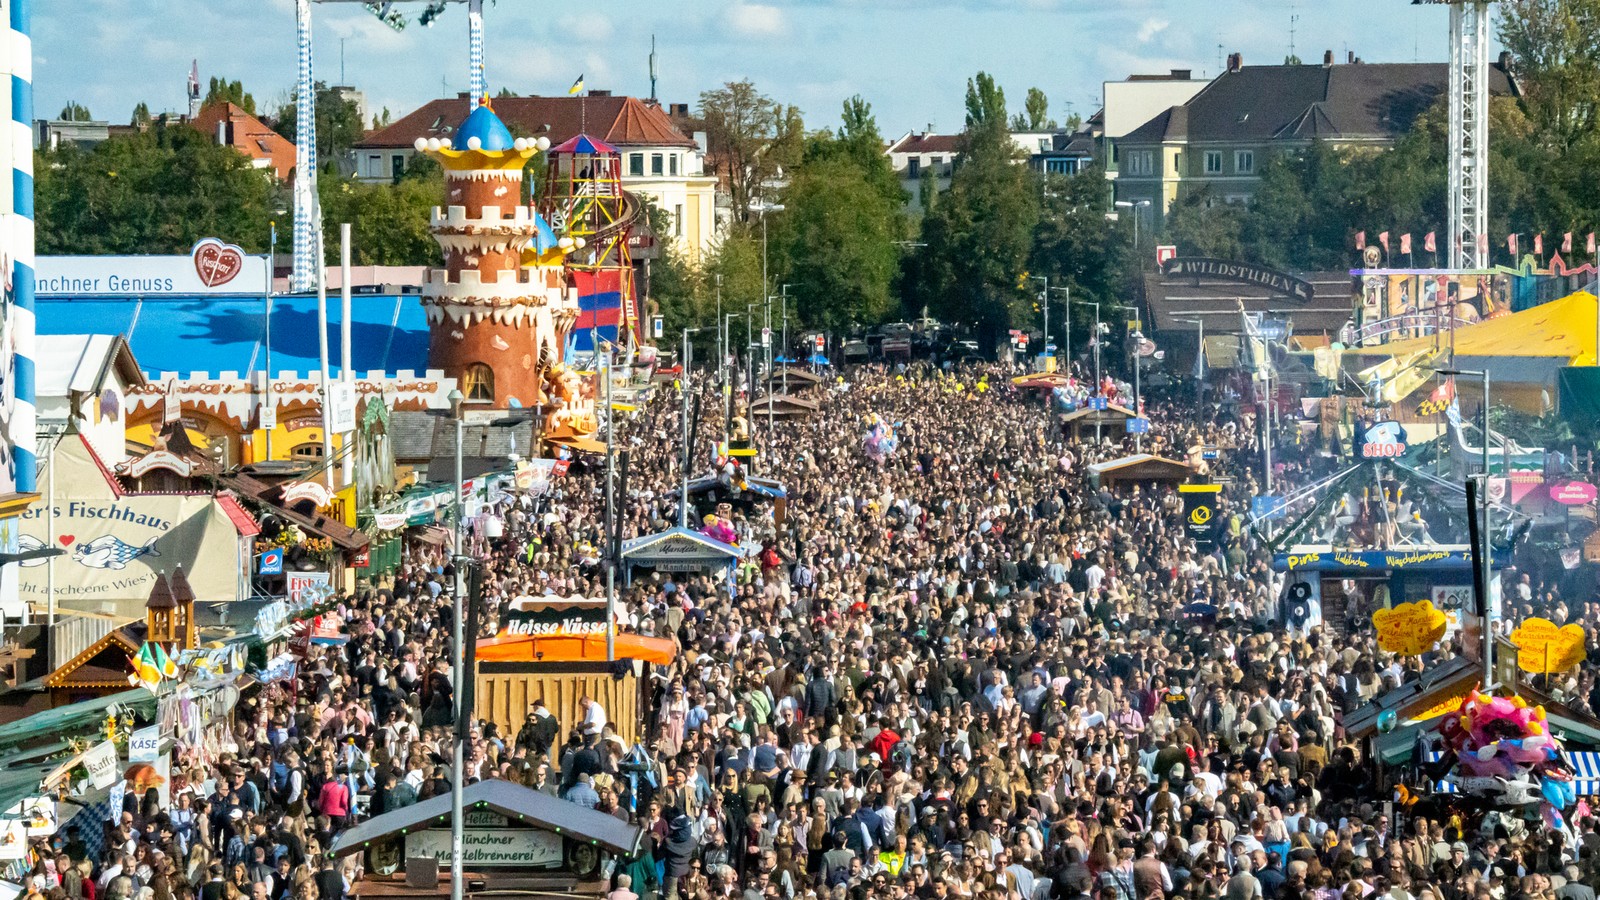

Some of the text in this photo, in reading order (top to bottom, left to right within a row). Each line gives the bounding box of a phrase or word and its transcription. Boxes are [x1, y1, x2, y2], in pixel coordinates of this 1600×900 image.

[108, 275, 173, 291] Genuss
[1186, 261, 1293, 292] WILDSTUBEN
[1363, 443, 1405, 457] SHOP
[69, 502, 171, 531] Fischhaus
[1287, 552, 1320, 570] Pins
[54, 584, 110, 595] scheene
[507, 617, 607, 635] Heisse Nüsse
[130, 737, 158, 750] KÄSE
[461, 834, 515, 846] ünchner
[434, 850, 534, 861] Madelbrennerei
